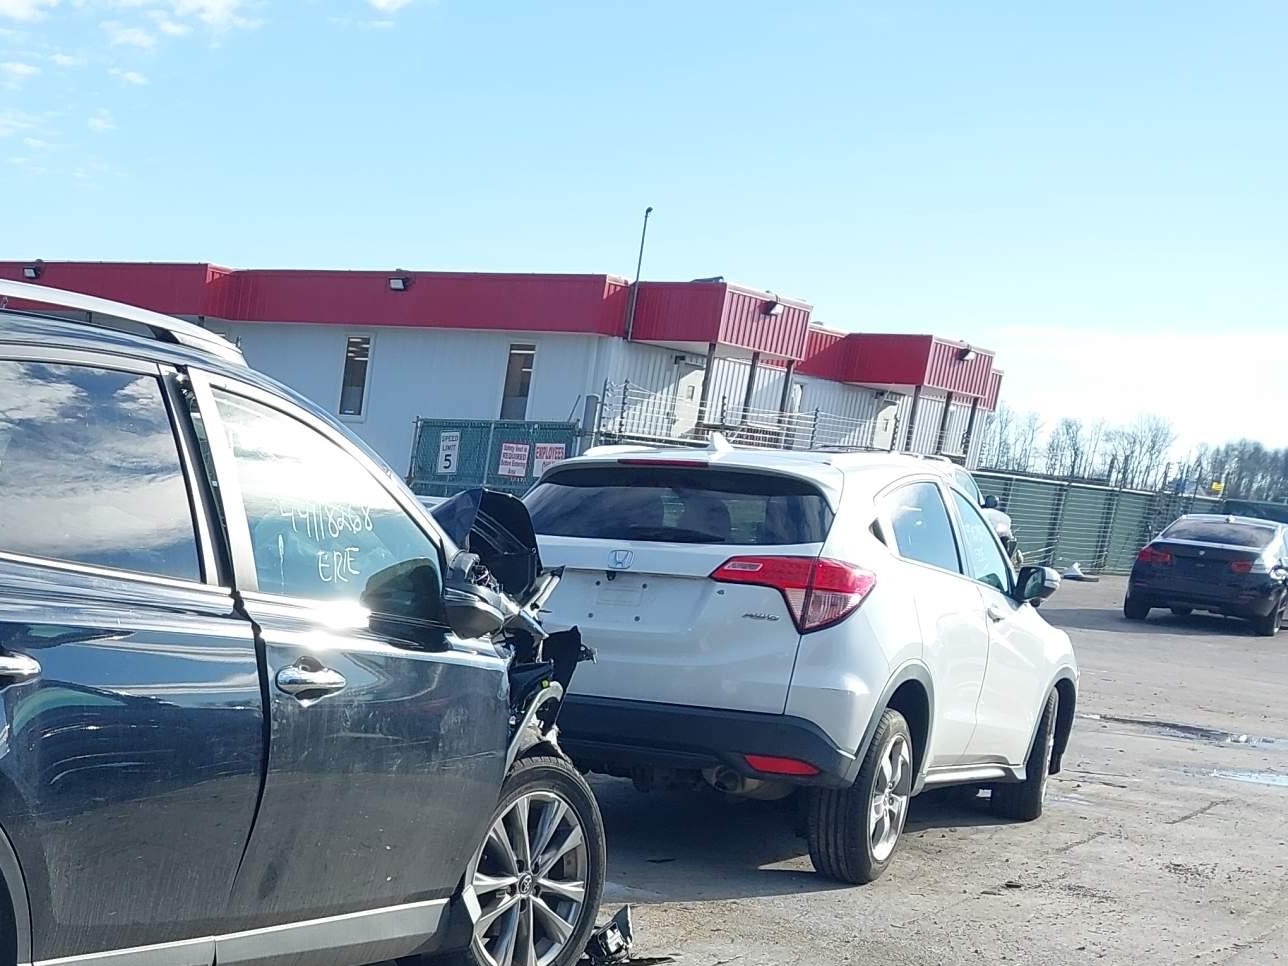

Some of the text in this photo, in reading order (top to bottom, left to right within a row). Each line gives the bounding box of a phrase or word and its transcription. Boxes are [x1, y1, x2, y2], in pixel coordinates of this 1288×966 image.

[503, 452, 527, 461] REQUIRED
[536, 447, 564, 459] EMPLOYEES
[443, 454, 452, 469] 5
[317, 547, 360, 583] ERIE
